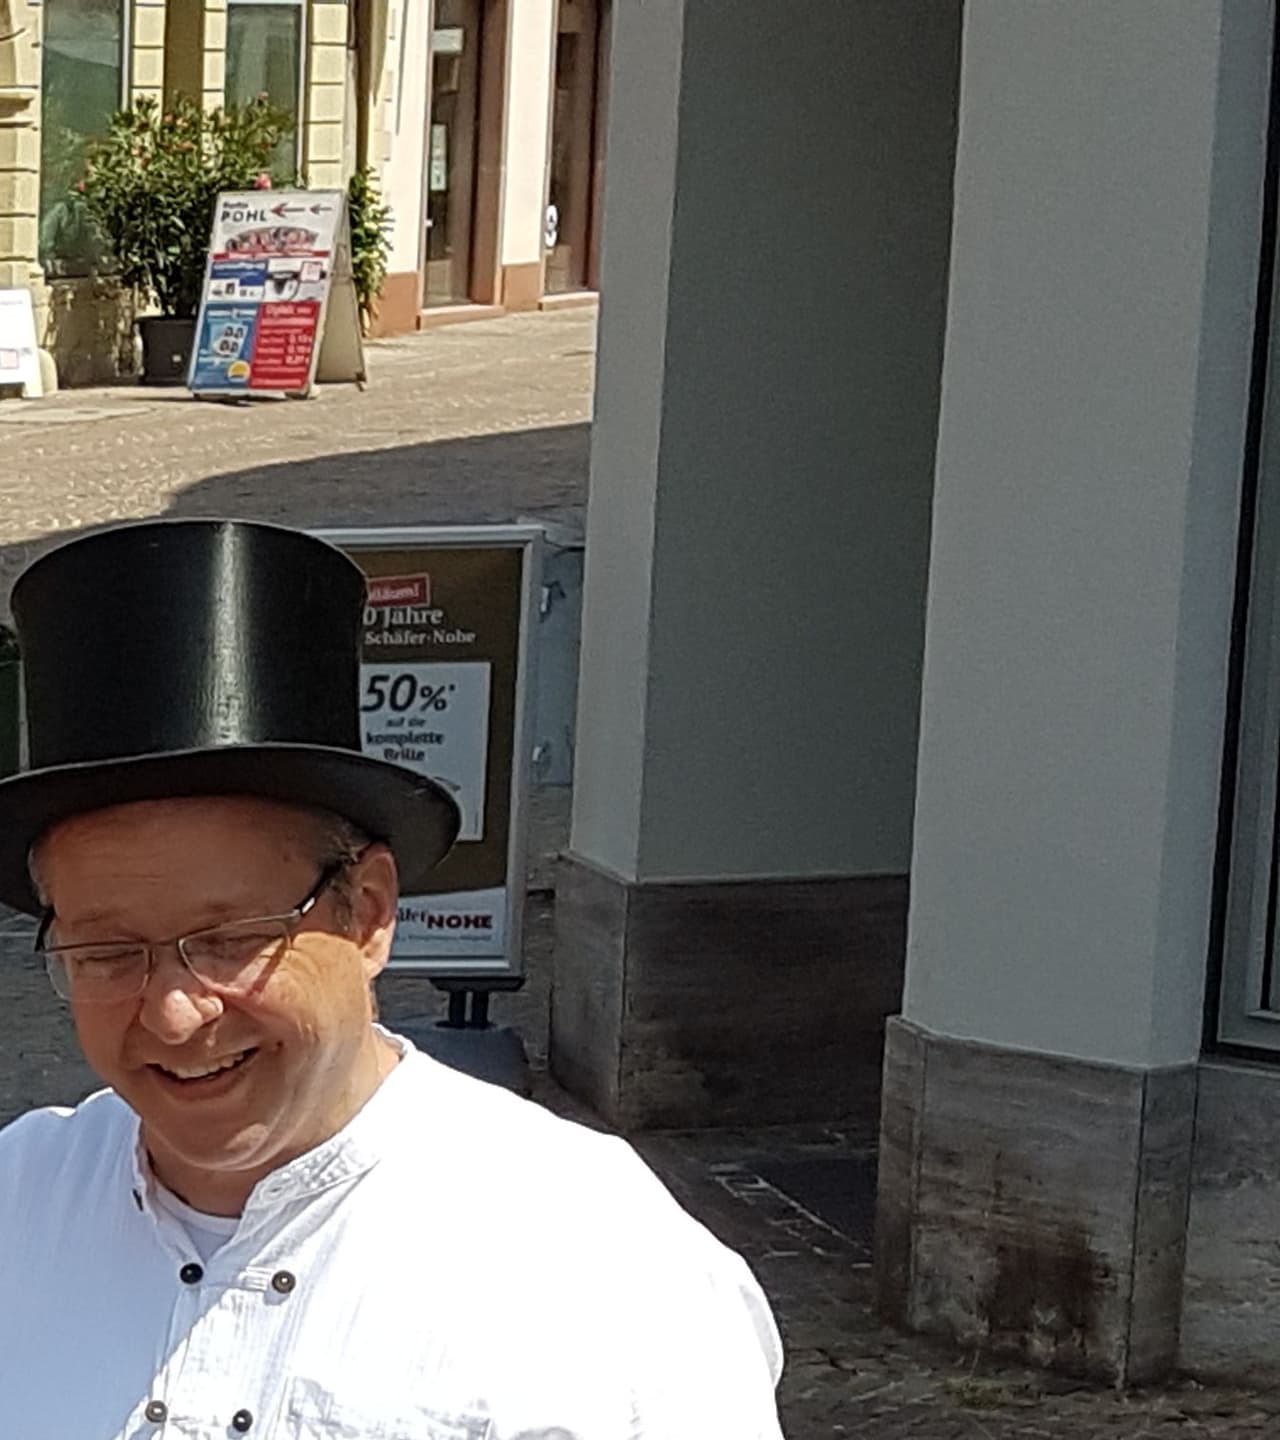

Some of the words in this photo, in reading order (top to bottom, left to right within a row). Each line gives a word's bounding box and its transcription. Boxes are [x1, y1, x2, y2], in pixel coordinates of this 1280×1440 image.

[383, 607, 444, 627] Jahre
[366, 731, 445, 748] komplette
[383, 747, 426, 761] Brille
